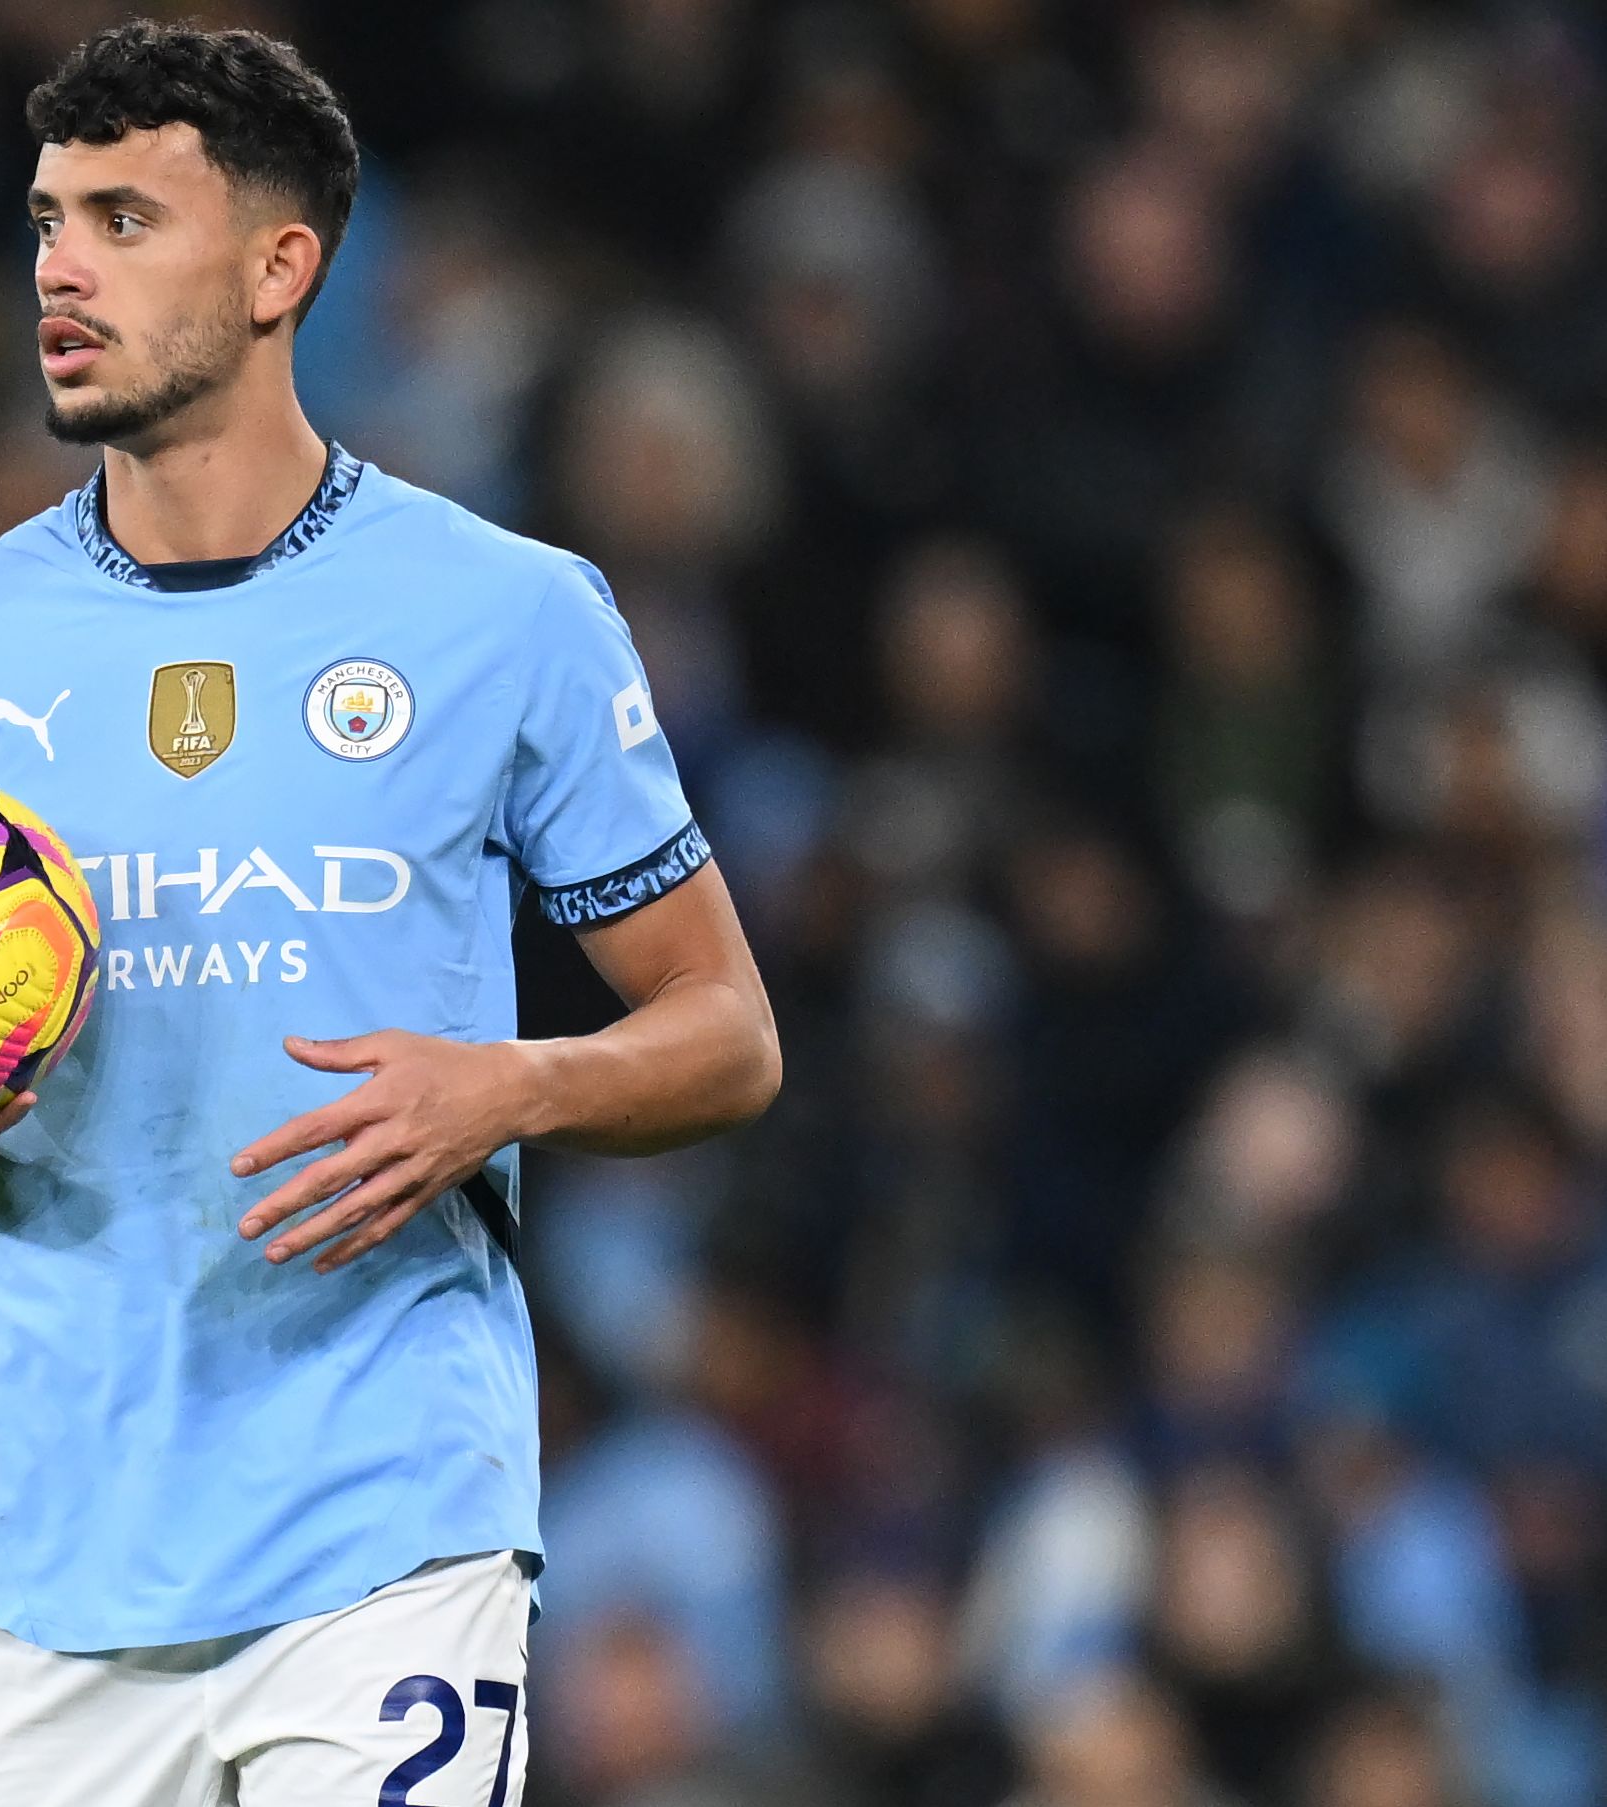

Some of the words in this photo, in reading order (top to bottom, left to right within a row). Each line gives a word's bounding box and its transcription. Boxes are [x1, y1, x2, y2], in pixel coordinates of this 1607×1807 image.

[317, 666, 403, 699] MANCHESTER
[173, 736, 211, 751] FIFA
[340, 744, 371, 754] CITY
[81, 845, 411, 920] IHAD
[108, 940, 308, 991] RWAYS
[378, 1675, 518, 1807] 27
